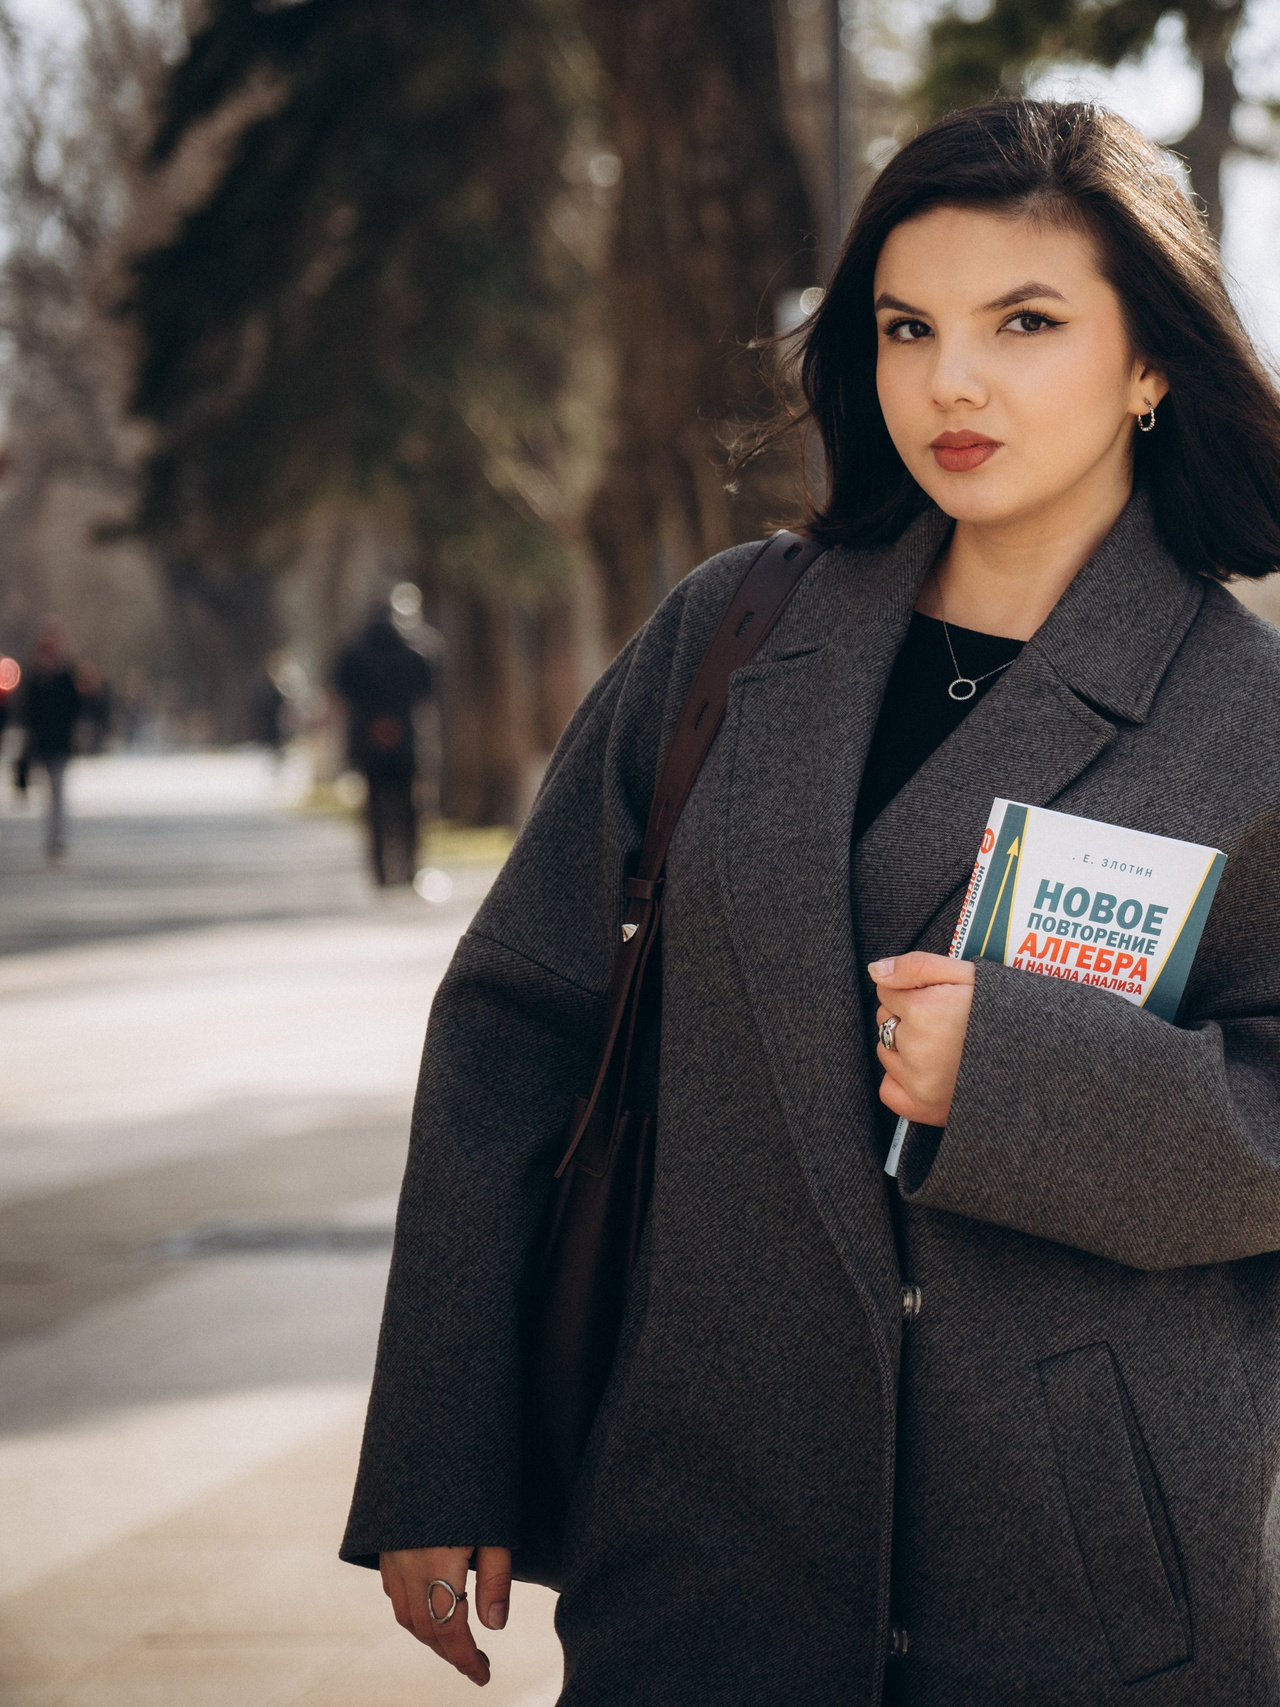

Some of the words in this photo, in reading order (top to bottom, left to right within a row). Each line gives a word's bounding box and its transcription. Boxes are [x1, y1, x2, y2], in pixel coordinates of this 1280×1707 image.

[969, 865, 985, 908] НОВОЕ
[1083, 854, 1094, 864] Е.
[1101, 858, 1153, 878] ЗЛОТИН
[1033, 878, 1169, 936] НОВОЕ
[954, 910, 972, 959] ПОВТОР
[1027, 912, 1158, 956] ПОВТОРЕНИЕ
[1012, 956, 1024, 970] И
[1025, 960, 1078, 981] НАЧАЛА
[1081, 972, 1142, 996] АНАЛИЗА
[1017, 932, 1147, 981] АЛГЕБРА
